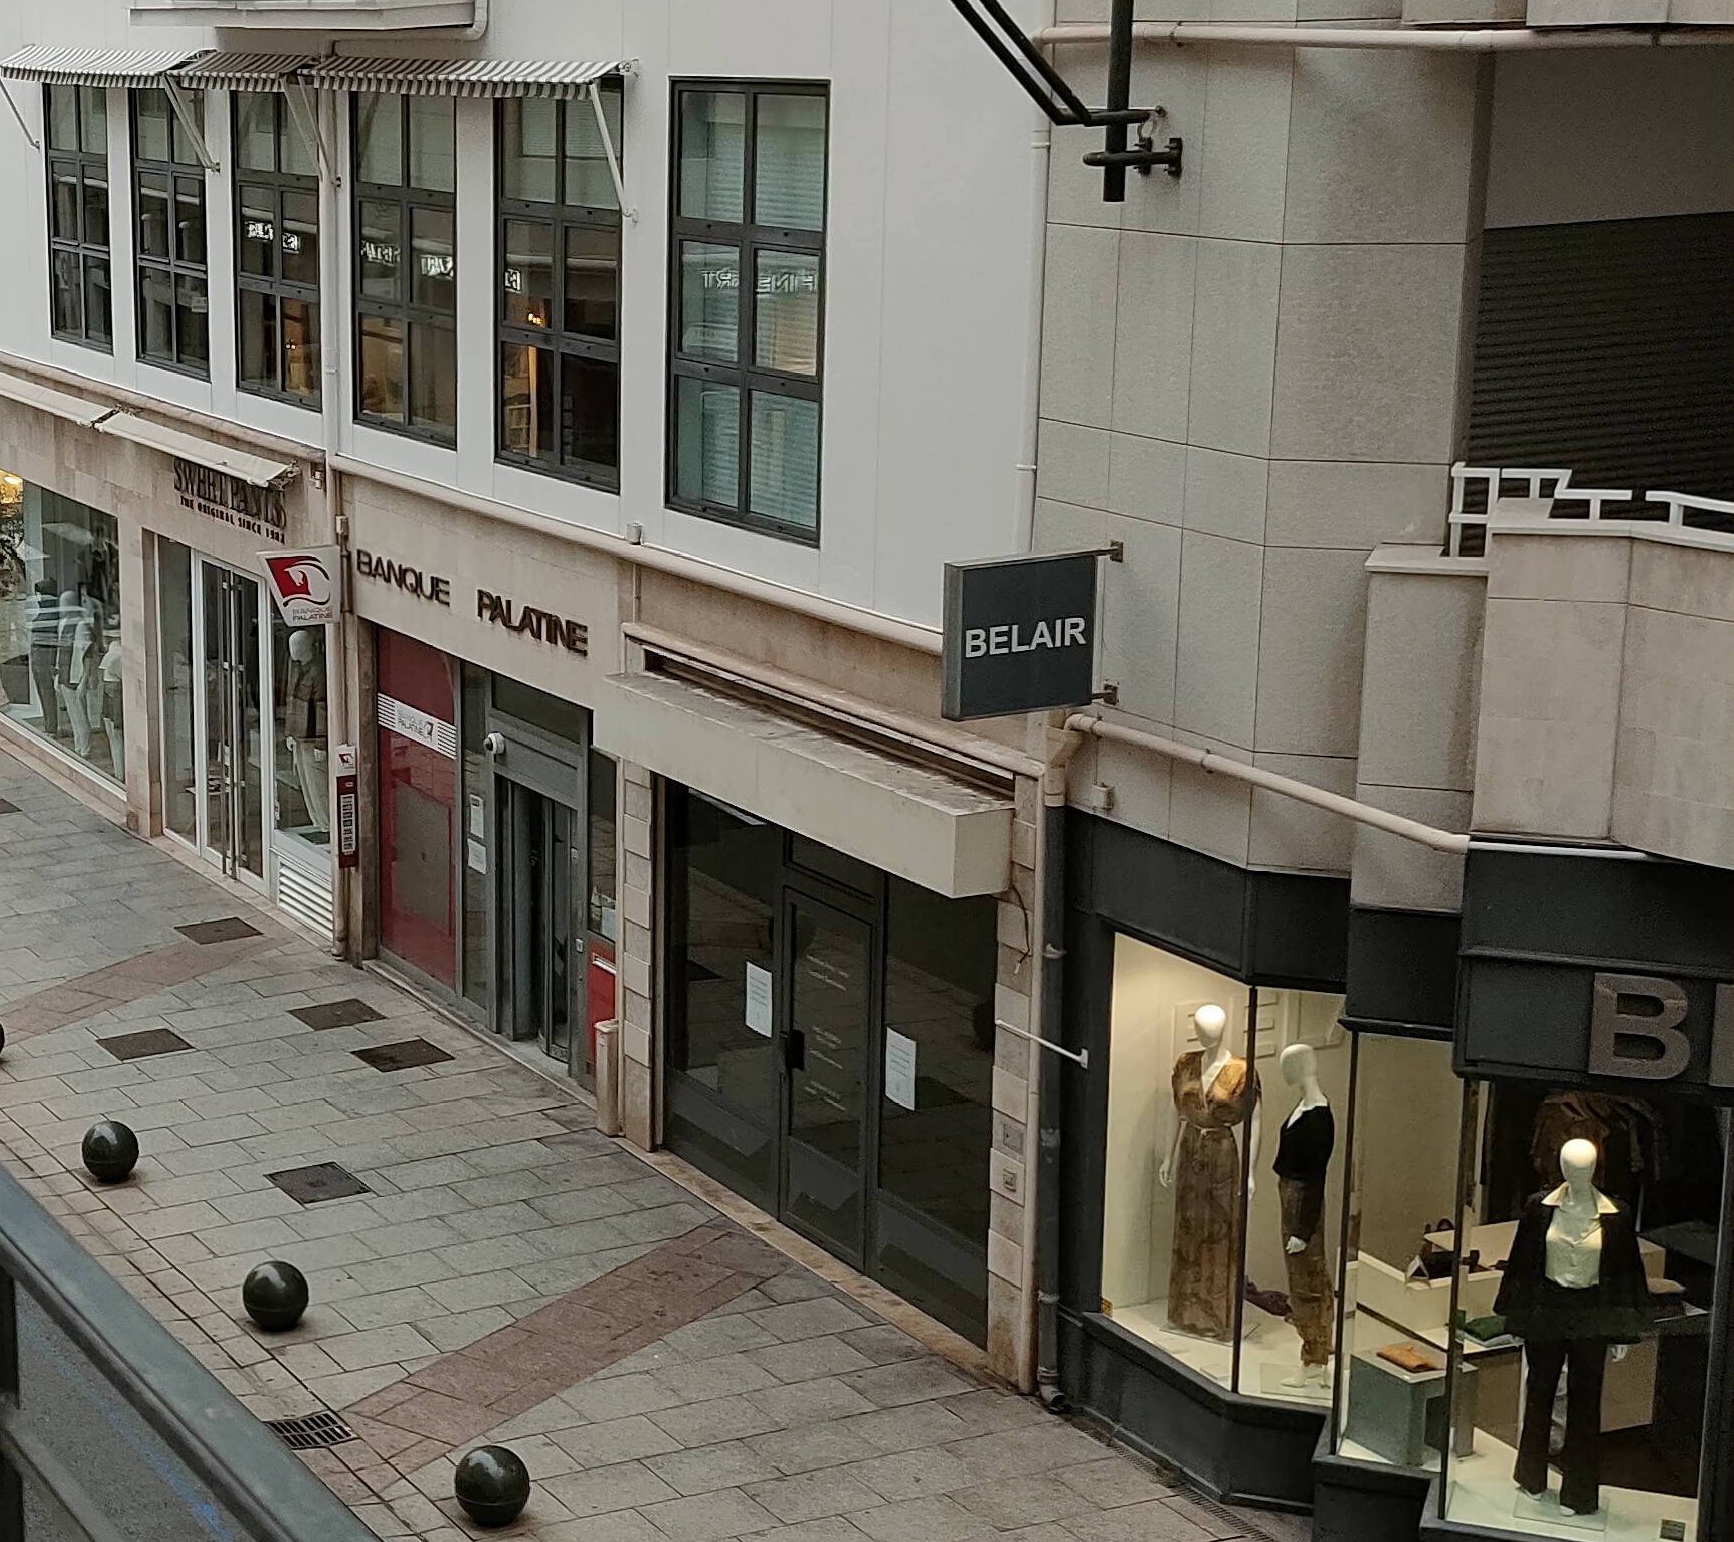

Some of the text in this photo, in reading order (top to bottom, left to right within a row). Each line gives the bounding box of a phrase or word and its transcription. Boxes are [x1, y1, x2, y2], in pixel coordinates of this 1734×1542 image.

[173, 458, 230, 509] SWEET
[197, 502, 236, 526] ORIGINAL
[237, 517, 263, 536] SINCE
[356, 549, 589, 658] BANQUE PALATINE
[965, 617, 1087, 658] BELAIR
